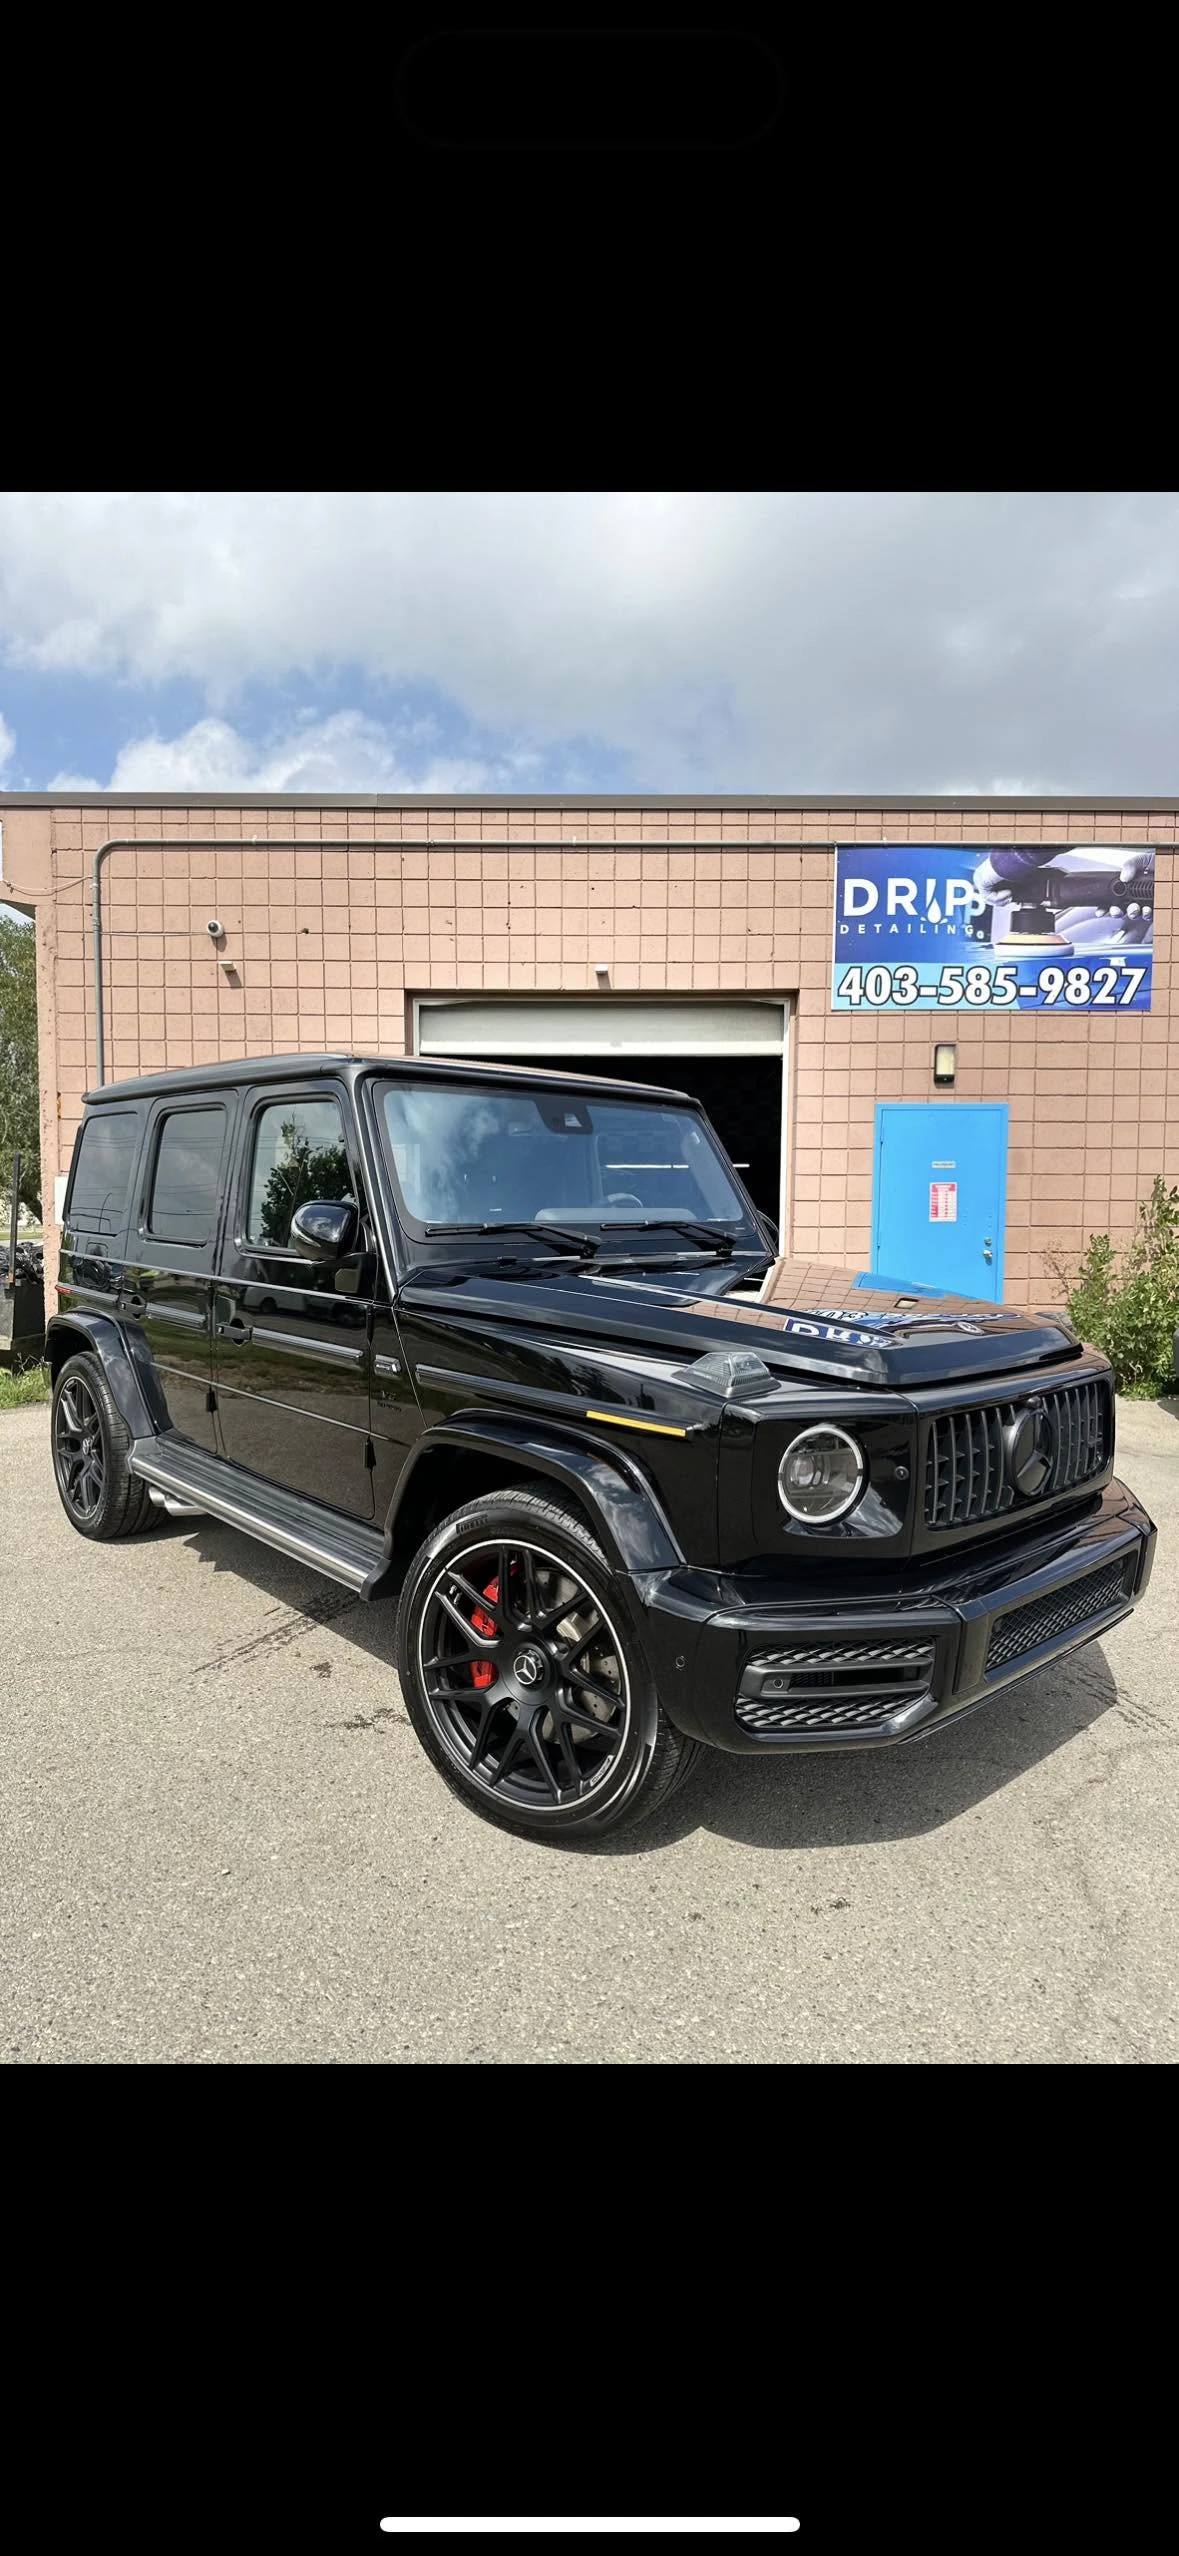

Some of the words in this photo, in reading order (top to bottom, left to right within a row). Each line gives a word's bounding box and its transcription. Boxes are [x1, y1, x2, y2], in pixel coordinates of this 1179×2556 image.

[843, 877, 975, 923] DRIP
[839, 923, 975, 935] DETAILING
[837, 965, 1147, 1006] 403-585-9827
